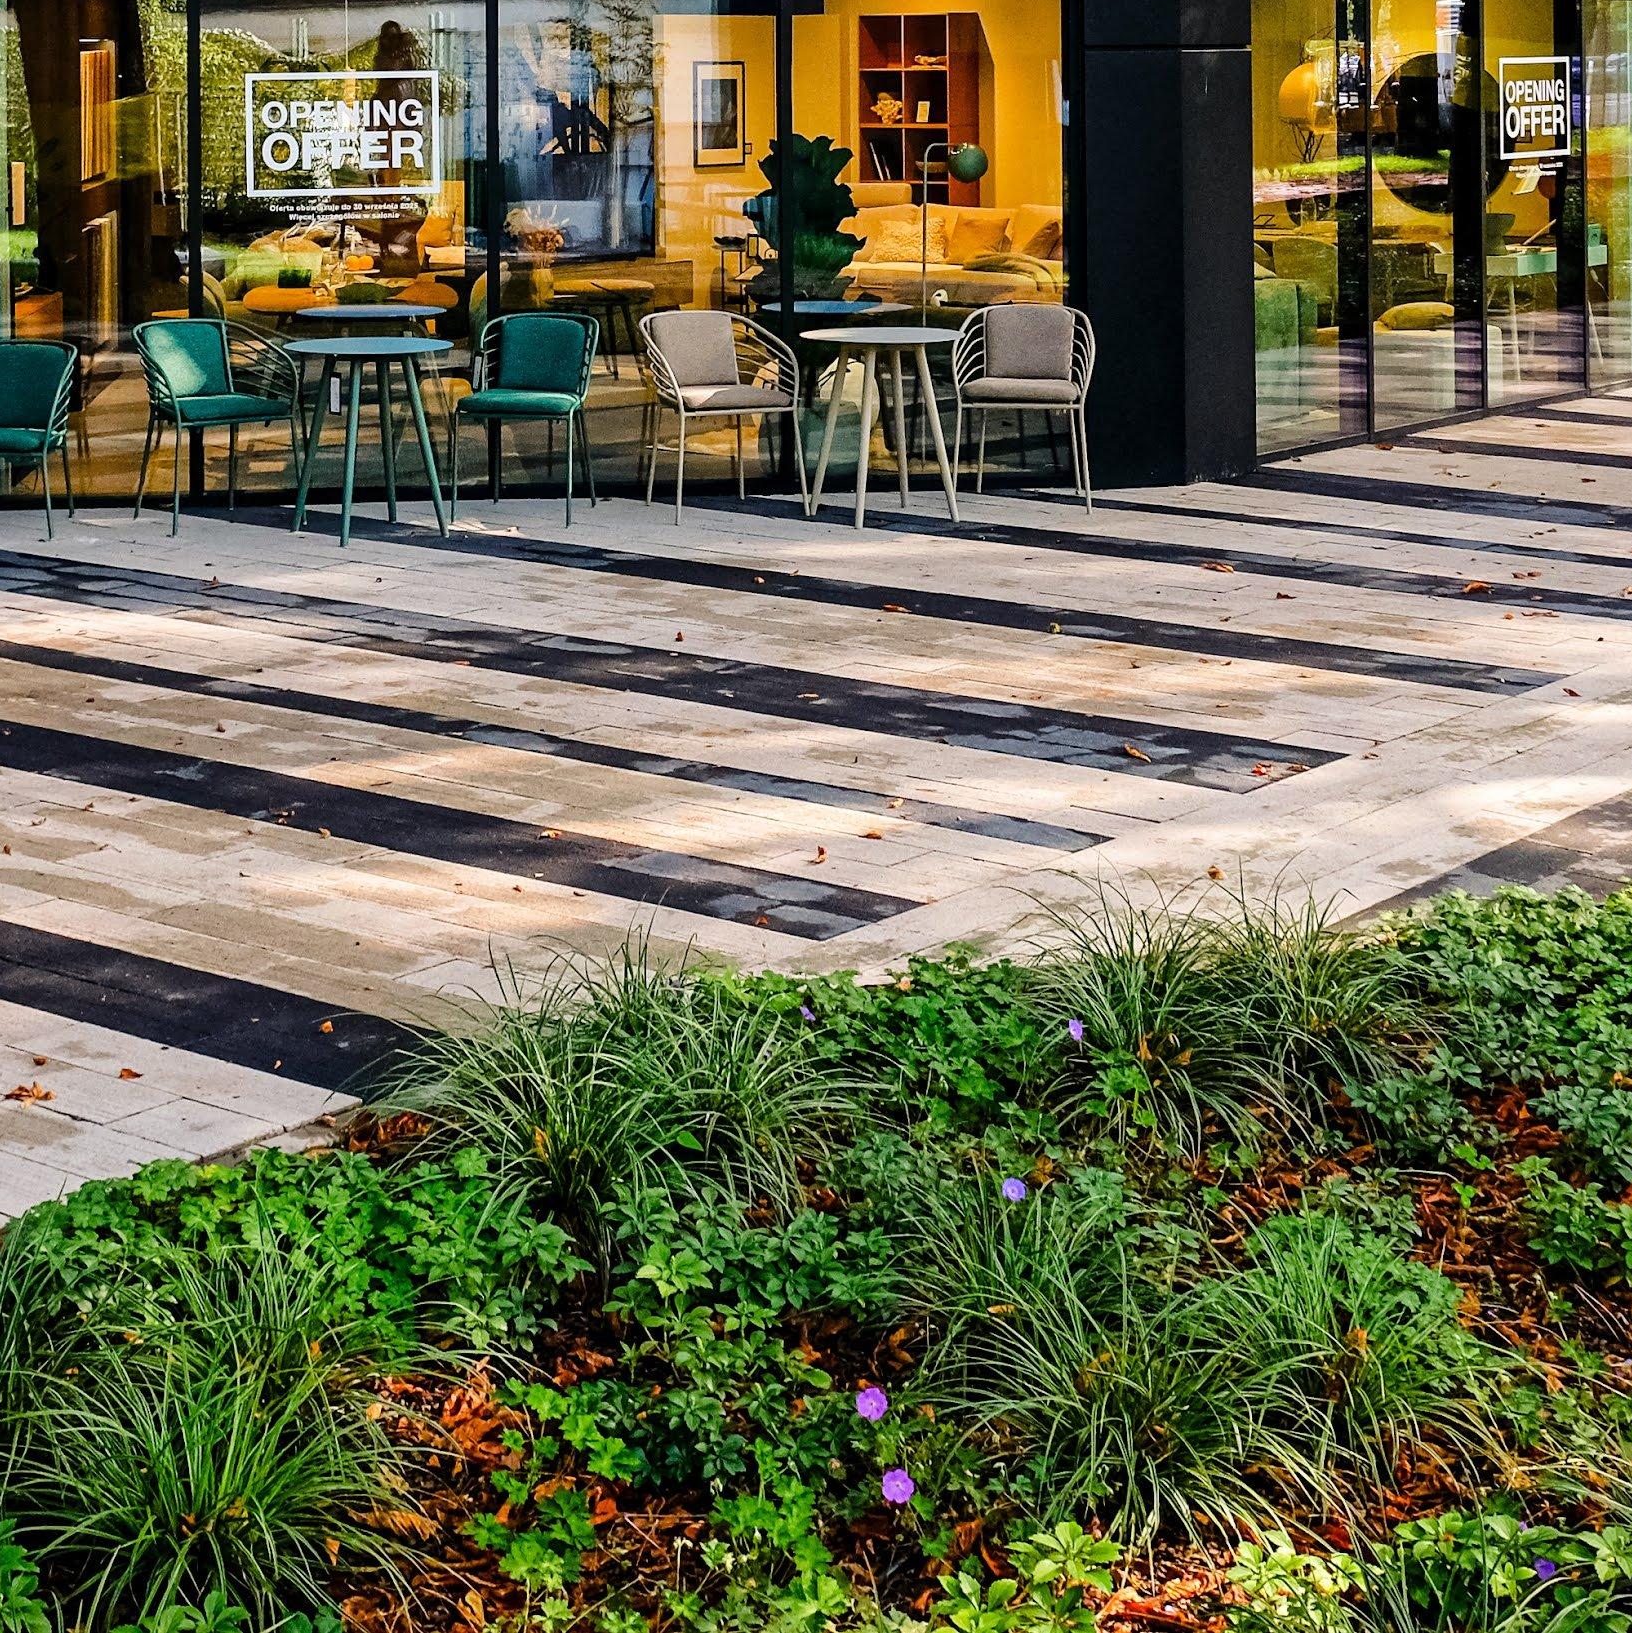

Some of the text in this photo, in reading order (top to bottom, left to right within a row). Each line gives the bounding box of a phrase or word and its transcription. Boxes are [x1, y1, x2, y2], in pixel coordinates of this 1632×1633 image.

[1505, 79, 1565, 103] OPENING
[262, 99, 424, 129] OPENING
[1505, 104, 1565, 138] OFFER
[262, 130, 425, 171] OFFER
[269, 204, 295, 213] Oferta
